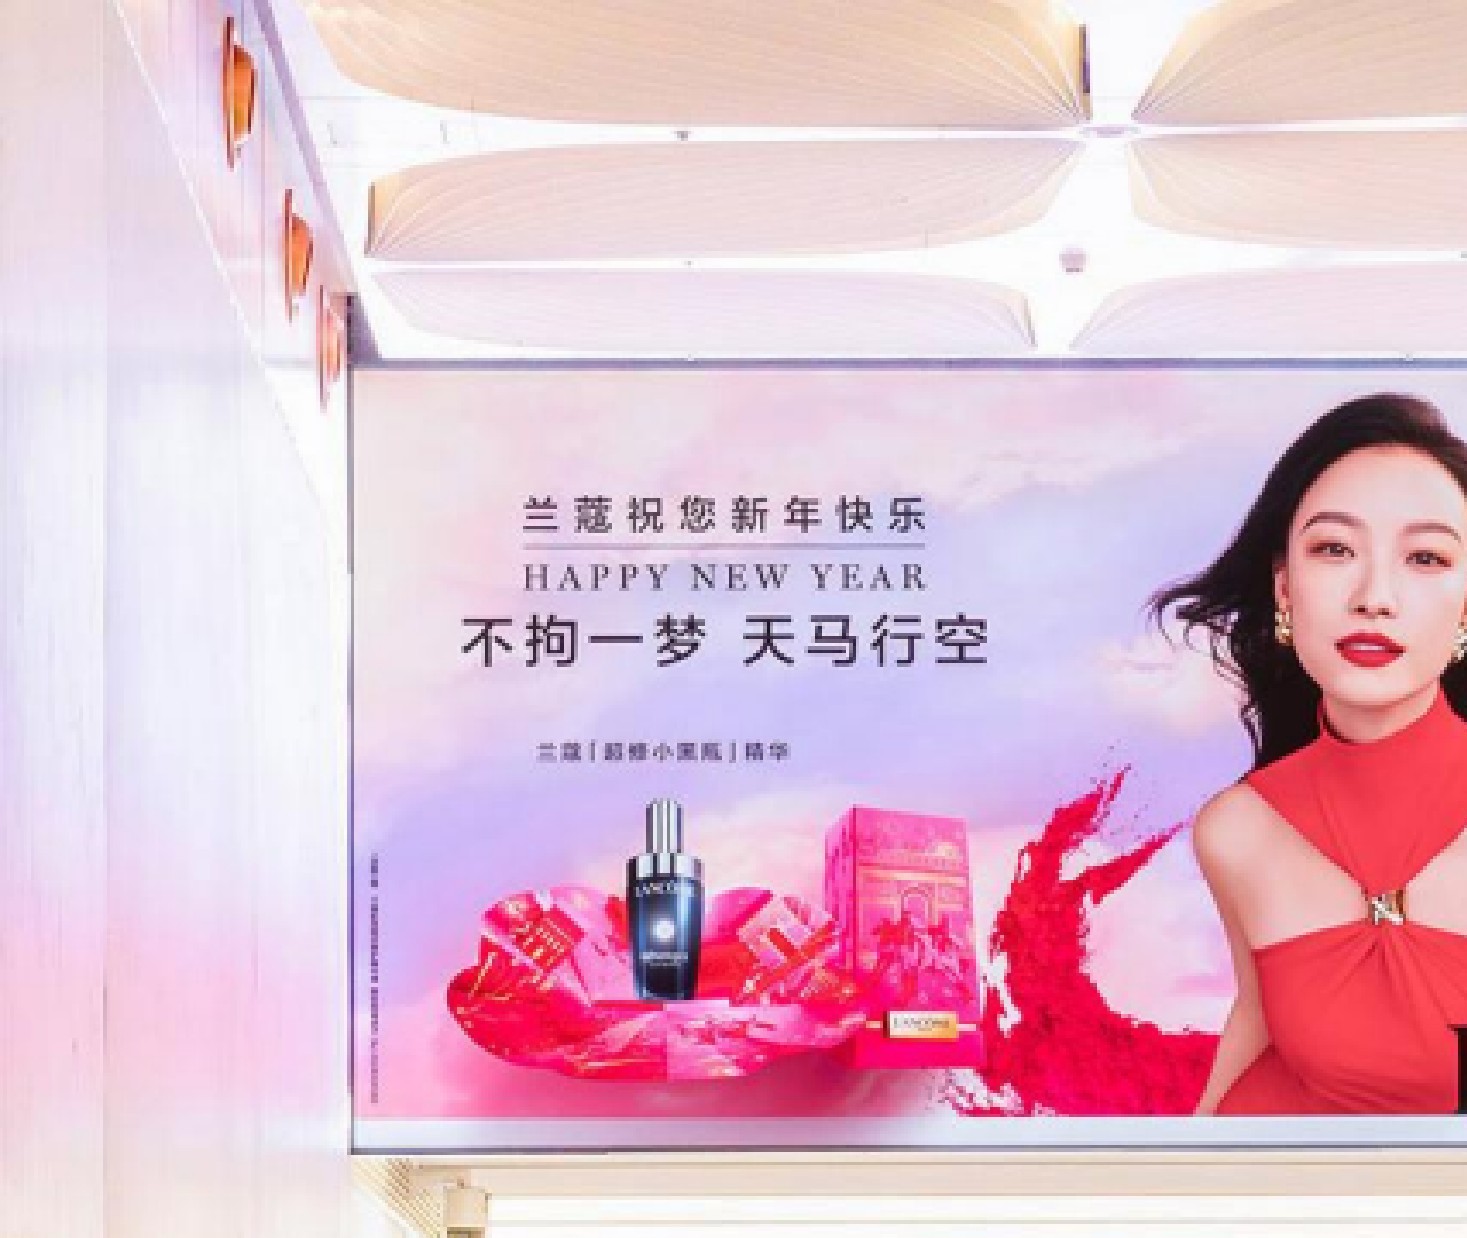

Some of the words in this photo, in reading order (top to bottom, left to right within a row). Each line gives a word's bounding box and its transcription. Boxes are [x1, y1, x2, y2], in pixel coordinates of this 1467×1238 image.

[521, 493, 928, 534] 兰蔻祝您新年快乐
[522, 562, 670, 592] HAPPY
[690, 562, 791, 592] NEW
[809, 562, 928, 592] YEAR
[460, 612, 707, 669] 不拘一梦
[741, 612, 989, 669] 天马行空
